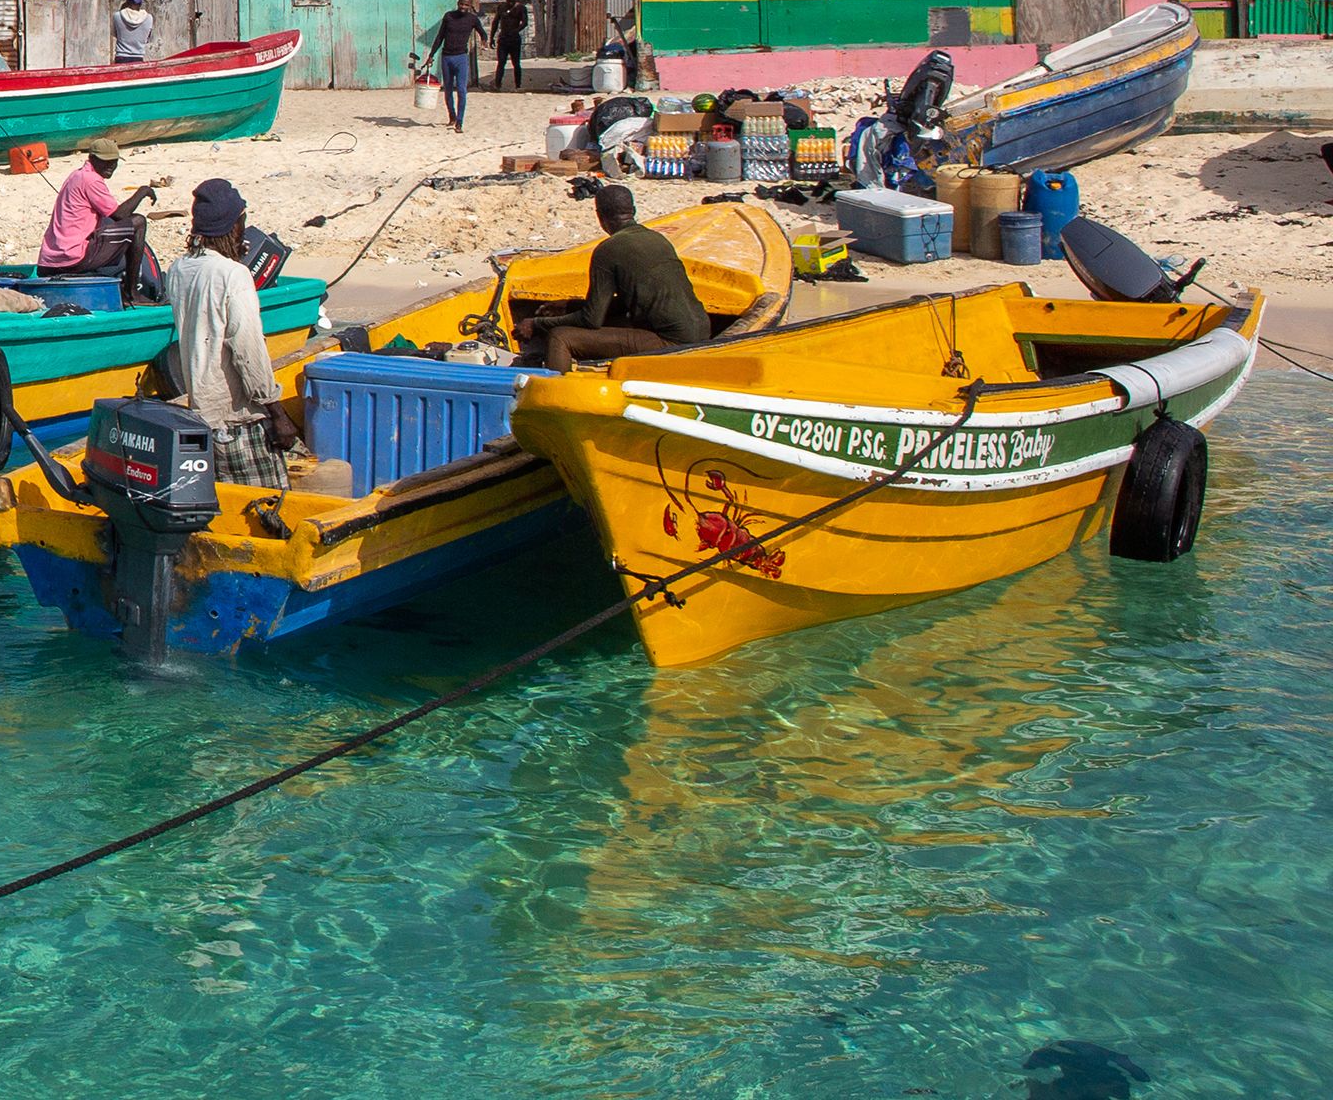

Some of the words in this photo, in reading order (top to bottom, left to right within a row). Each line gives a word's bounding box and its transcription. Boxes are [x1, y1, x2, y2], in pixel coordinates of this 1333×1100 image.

[251, 251, 269, 277] AMAHA
[750, 412, 842, 452] 6Y-02801
[895, 427, 1007, 470] PRICELESS
[1008, 427, 1056, 468] Baby
[126, 465, 152, 482] Enduro
[179, 459, 208, 472] 40
